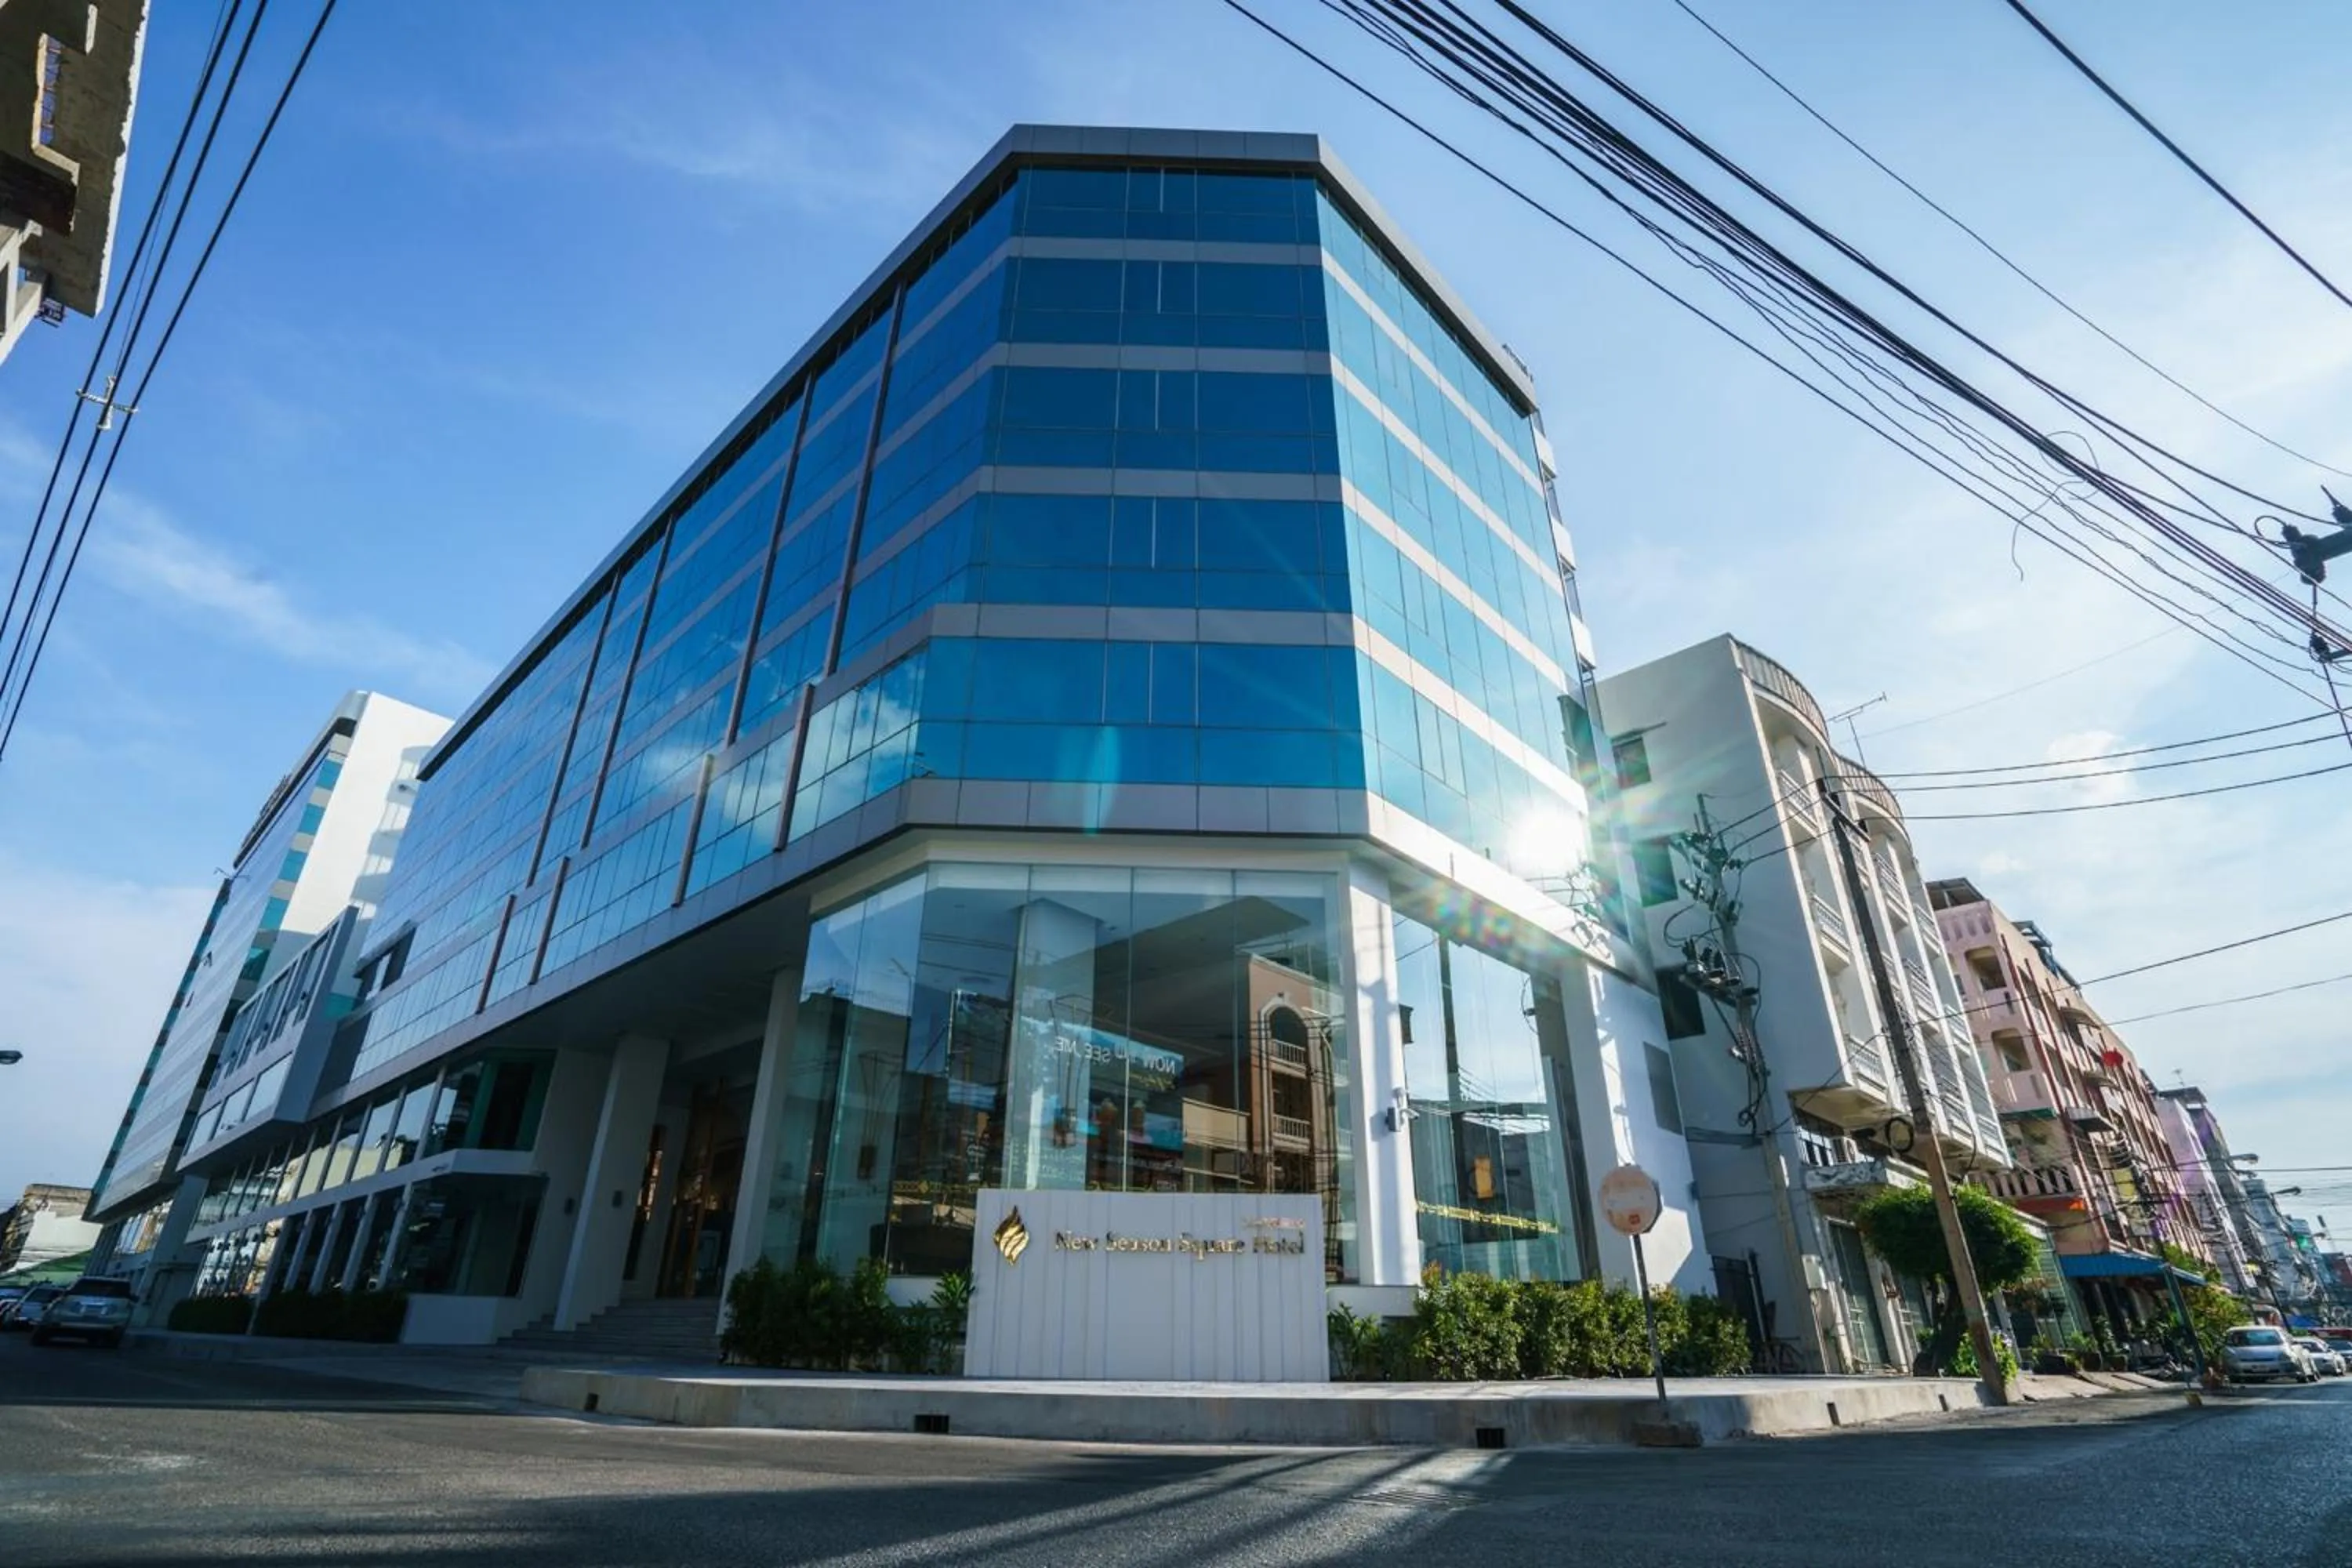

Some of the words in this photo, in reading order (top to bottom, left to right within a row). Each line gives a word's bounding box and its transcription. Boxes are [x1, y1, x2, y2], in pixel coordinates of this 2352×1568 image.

[1052, 1230, 1098, 1251] New
[1105, 1231, 1171, 1253] Season
[1178, 1231, 1245, 1261] Square
[1253, 1231, 1305, 1254] Hotel
